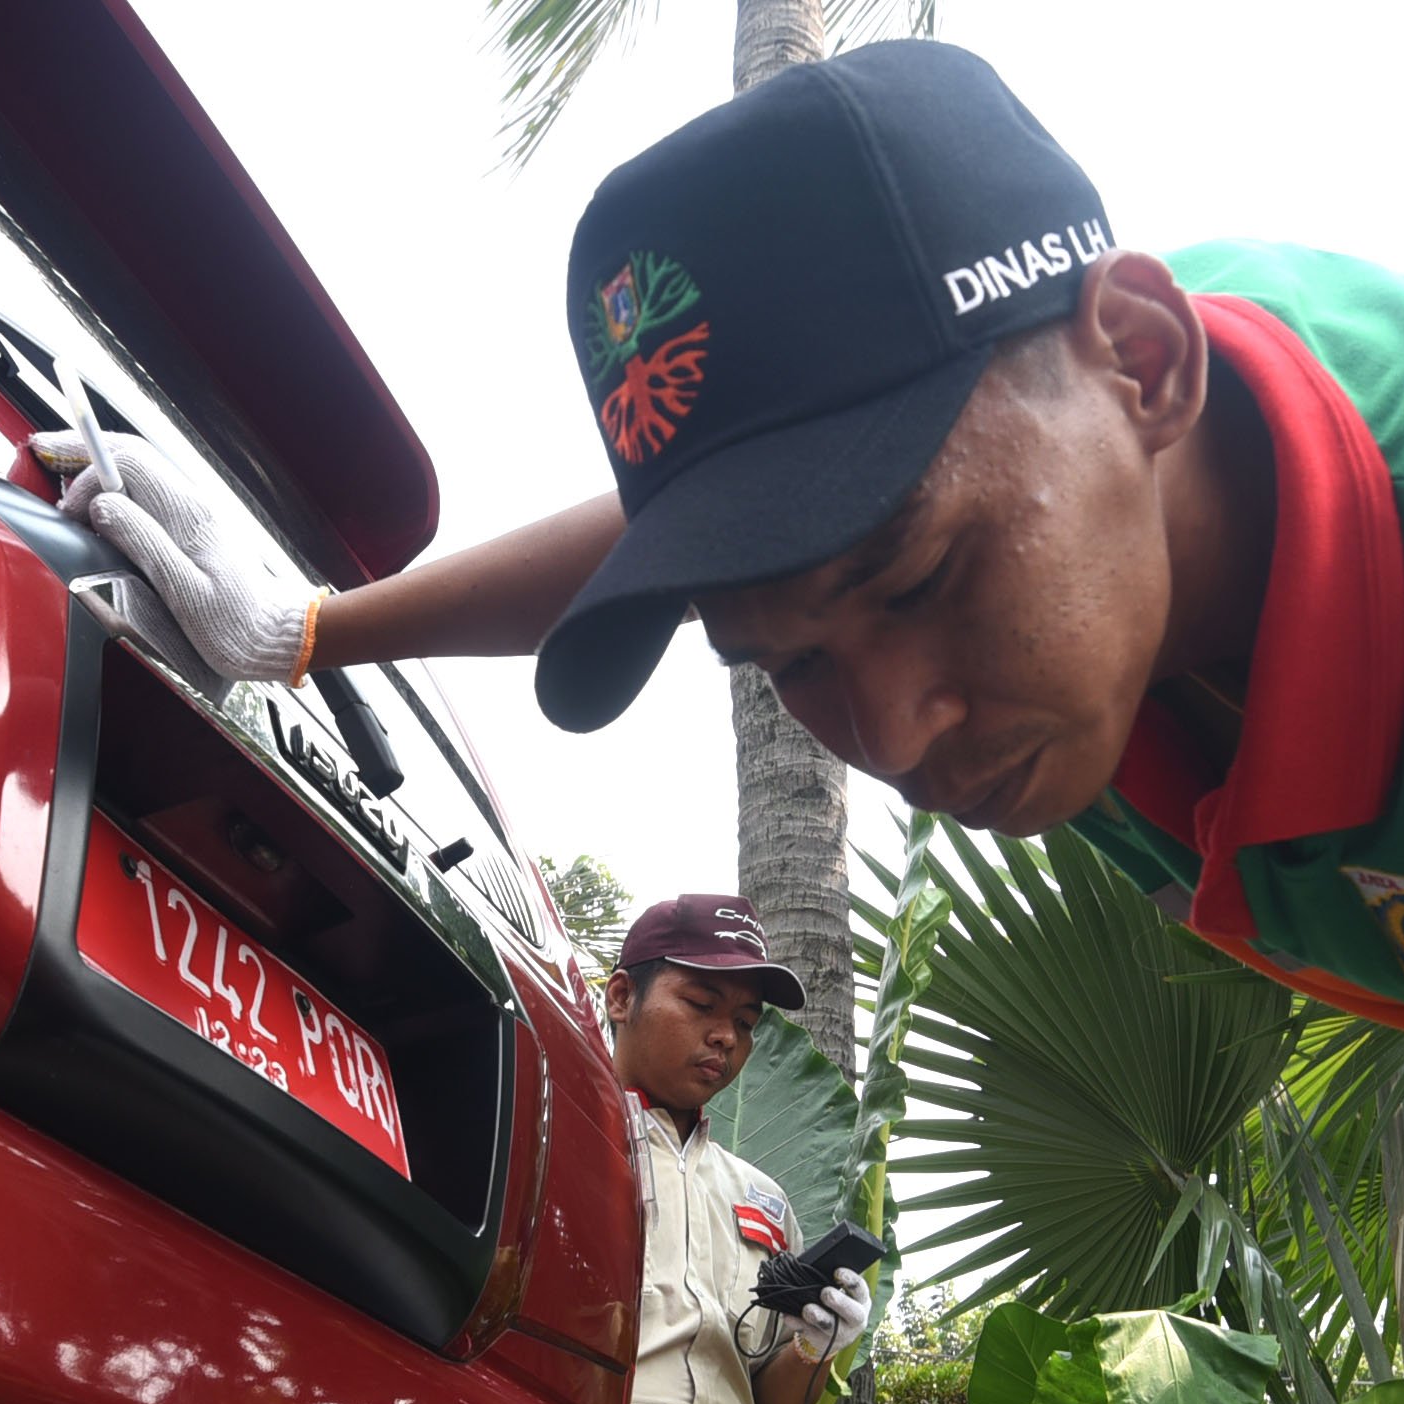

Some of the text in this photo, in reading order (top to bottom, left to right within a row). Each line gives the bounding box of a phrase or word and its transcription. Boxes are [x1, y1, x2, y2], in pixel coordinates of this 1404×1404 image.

[942, 217, 1109, 316] DINAS LH
[288, 722, 407, 853] ISUZU
[137, 860, 397, 1149] 1242 PQR
